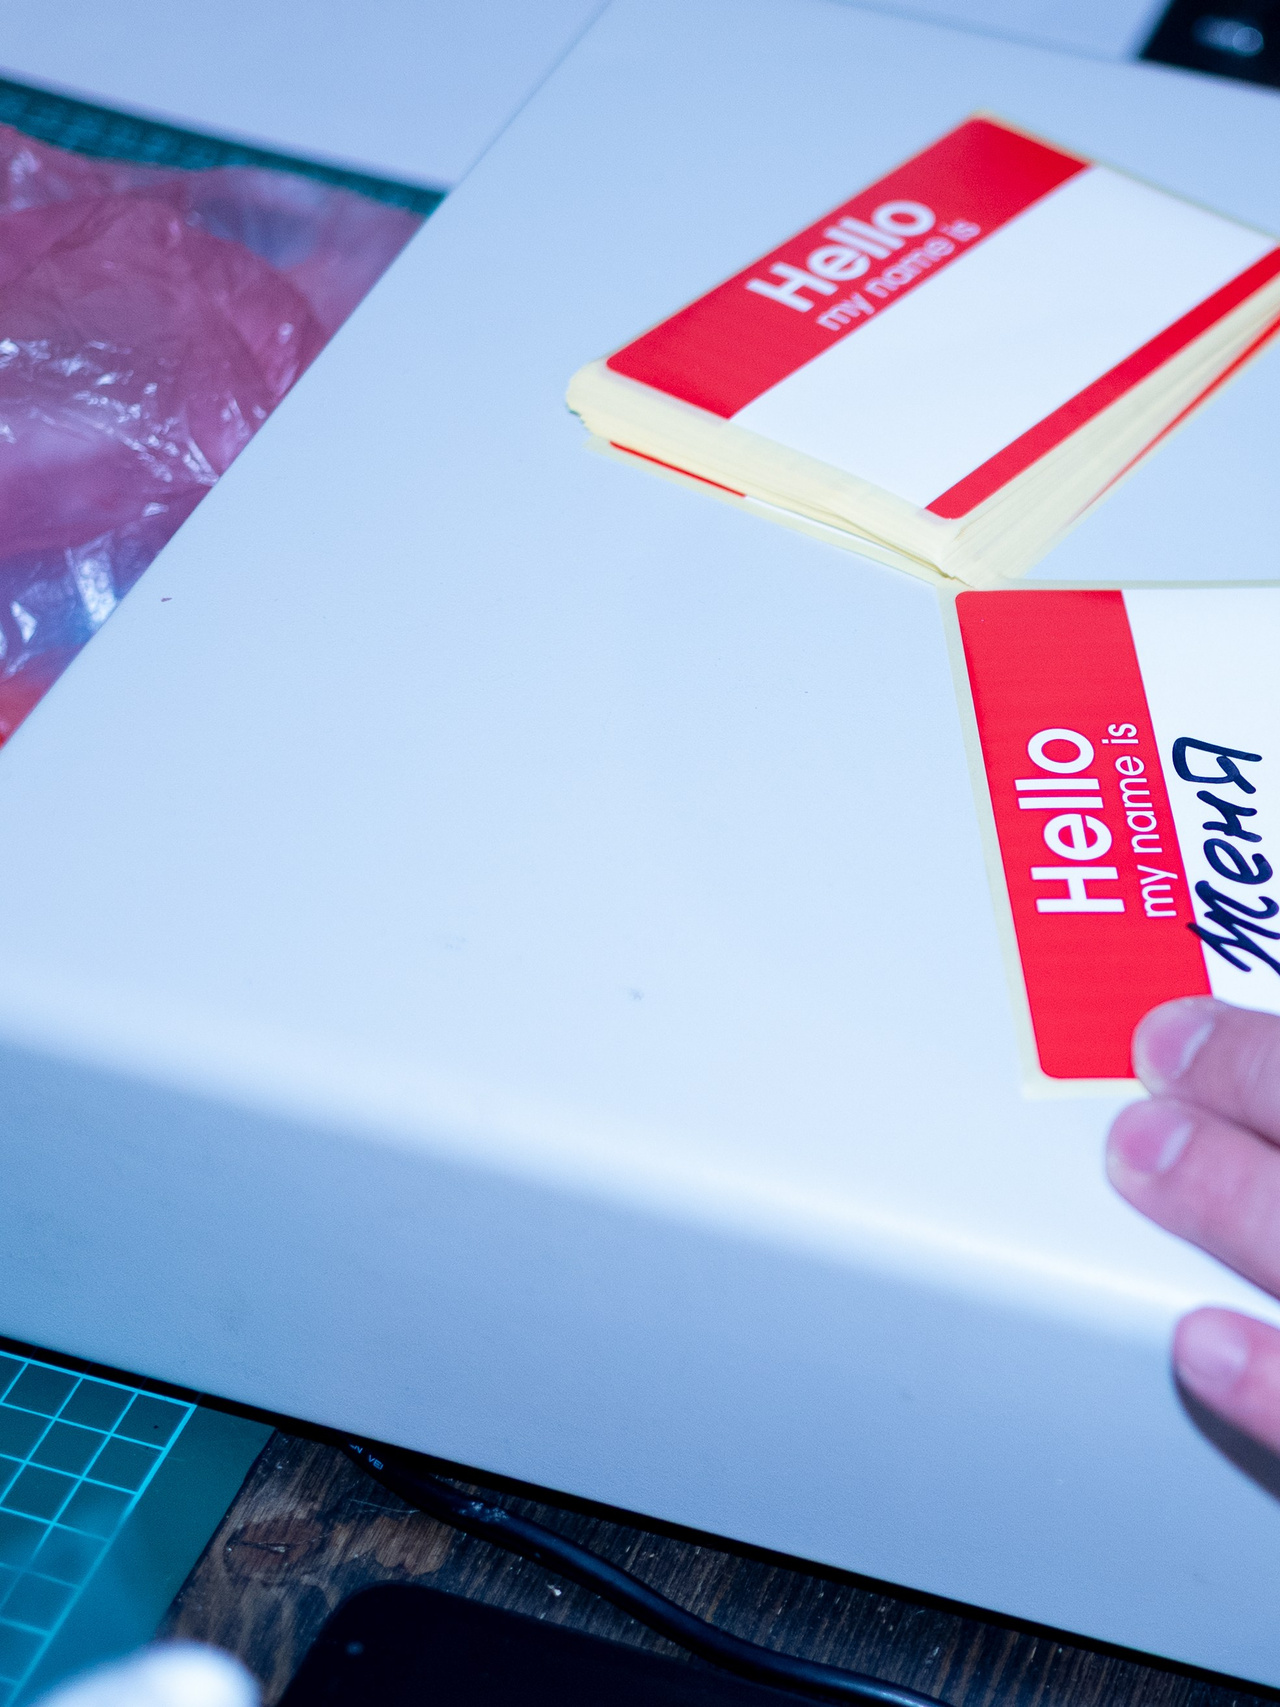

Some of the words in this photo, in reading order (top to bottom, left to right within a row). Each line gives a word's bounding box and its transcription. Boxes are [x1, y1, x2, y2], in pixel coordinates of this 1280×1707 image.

[745, 200, 937, 313] Hello
[815, 292, 876, 332] my
[864, 236, 955, 298] name
[938, 219, 981, 242] is
[1101, 722, 1139, 745] is
[1014, 727, 1126, 914] Hello
[1115, 755, 1163, 854] name
[1136, 864, 1179, 918] my
